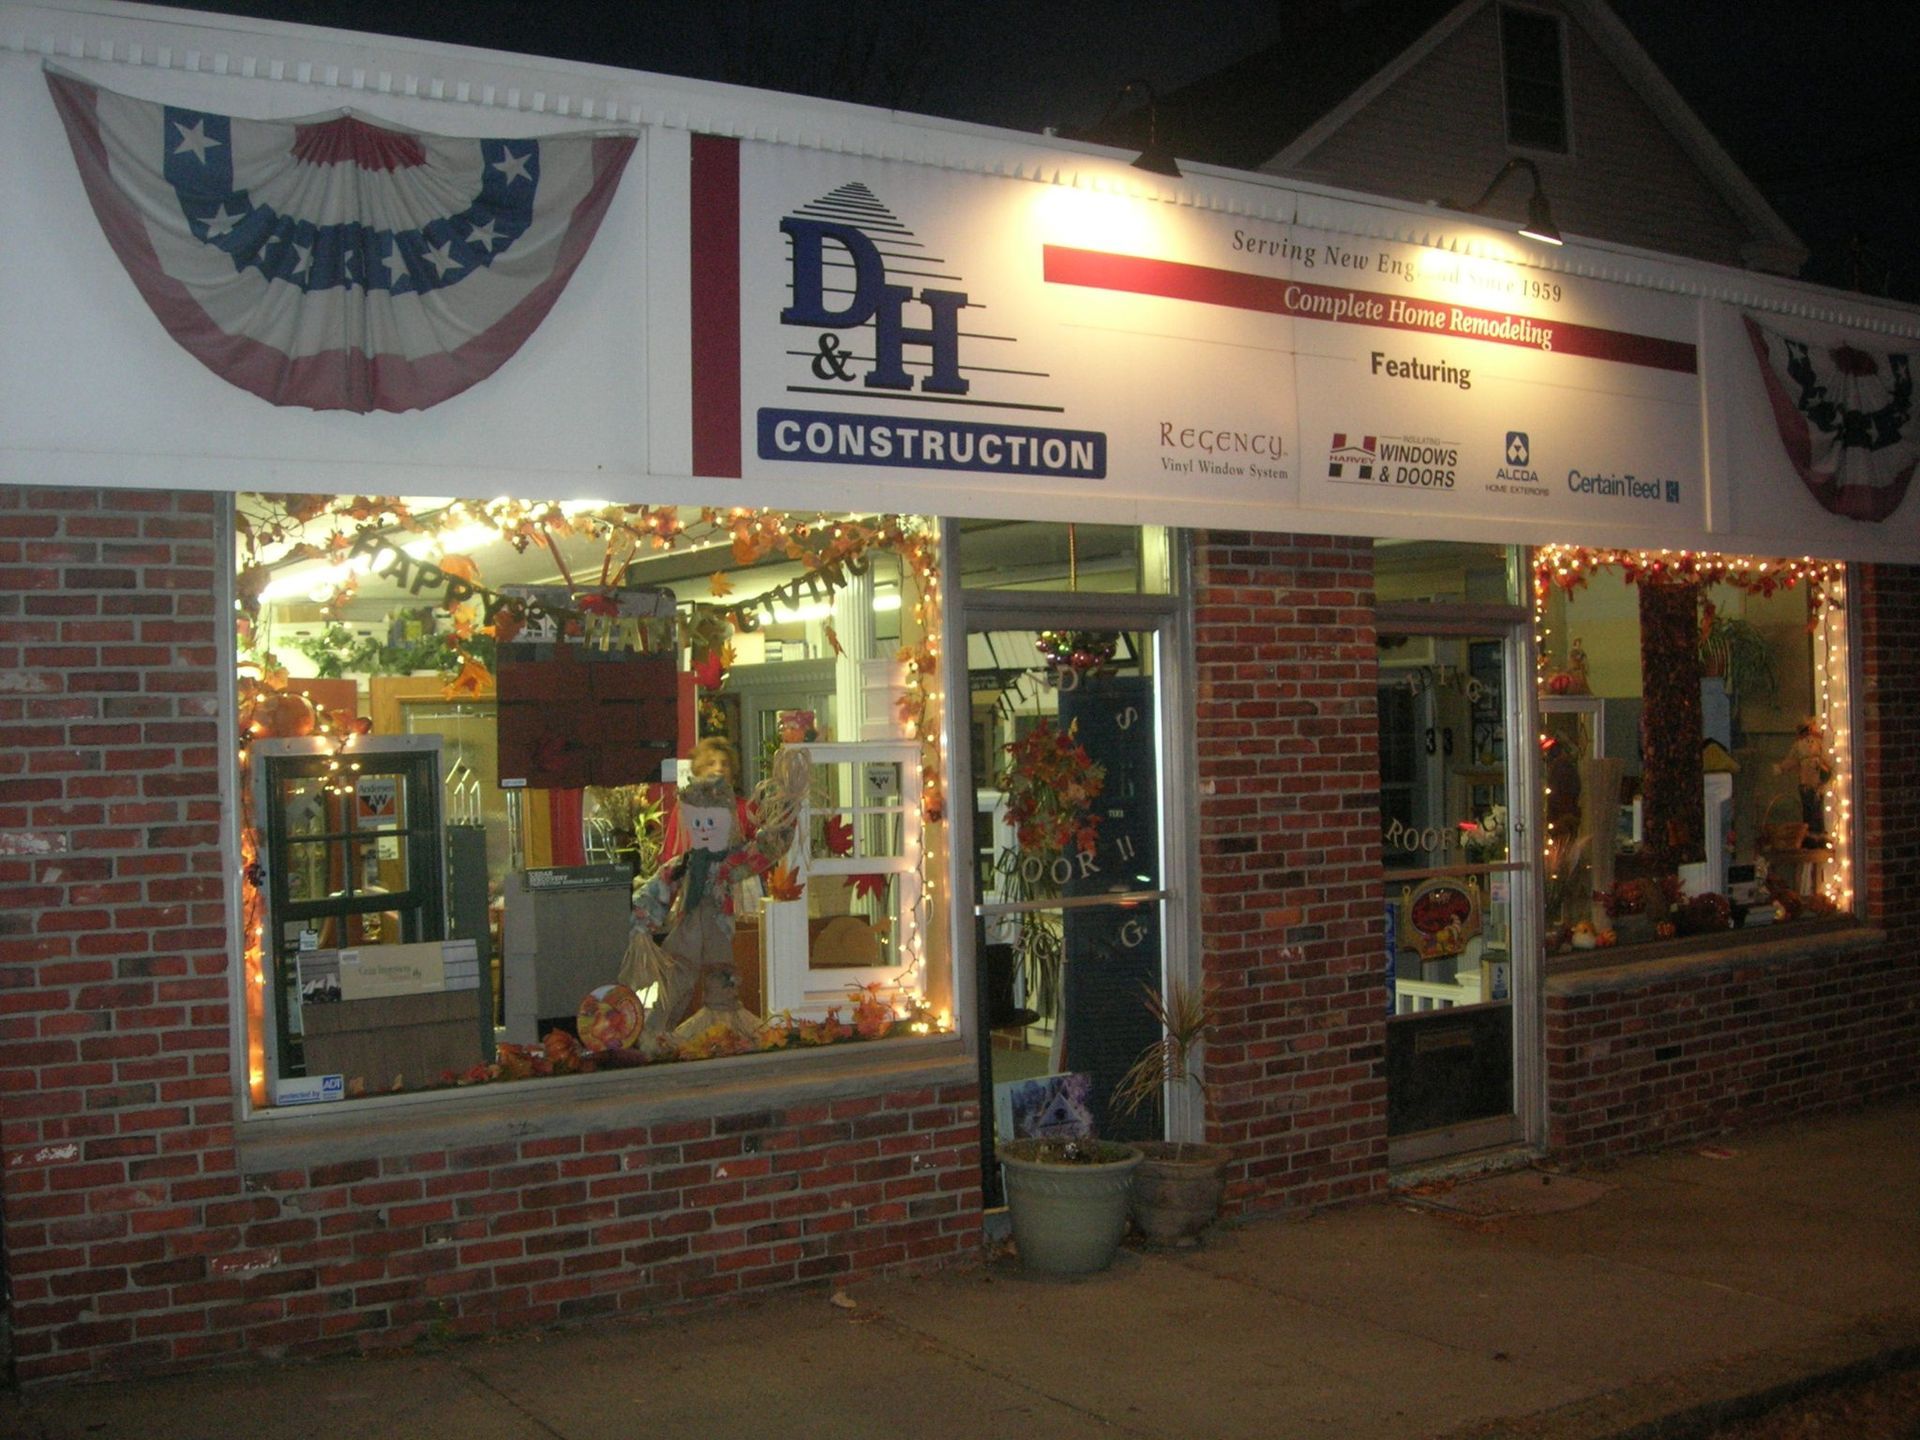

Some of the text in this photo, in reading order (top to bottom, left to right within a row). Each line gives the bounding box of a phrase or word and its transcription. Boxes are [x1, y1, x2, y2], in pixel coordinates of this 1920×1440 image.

[1232, 229, 1316, 268] Serving
[1324, 245, 1368, 271] New
[1377, 252, 1461, 284] Engnd
[1522, 278, 1563, 303] 1959
[1284, 285, 1553, 352] Complete Home Remodeling
[1371, 351, 1472, 391] Featuring
[774, 419, 1095, 471] CONSTRUCTION
[1160, 421, 1283, 460] REGENCY
[1329, 455, 1376, 465] HARVEY
[1380, 444, 1458, 467] WINDOWS
[1161, 457, 1289, 480] Vinyl Window System
[1379, 466, 1456, 488] & DOORS
[1496, 468, 1539, 482] ALCOA
[1485, 484, 1508, 494] HOME
[1568, 469, 1661, 500] CertainTeed
[323, 1079, 341, 1089] ADT
